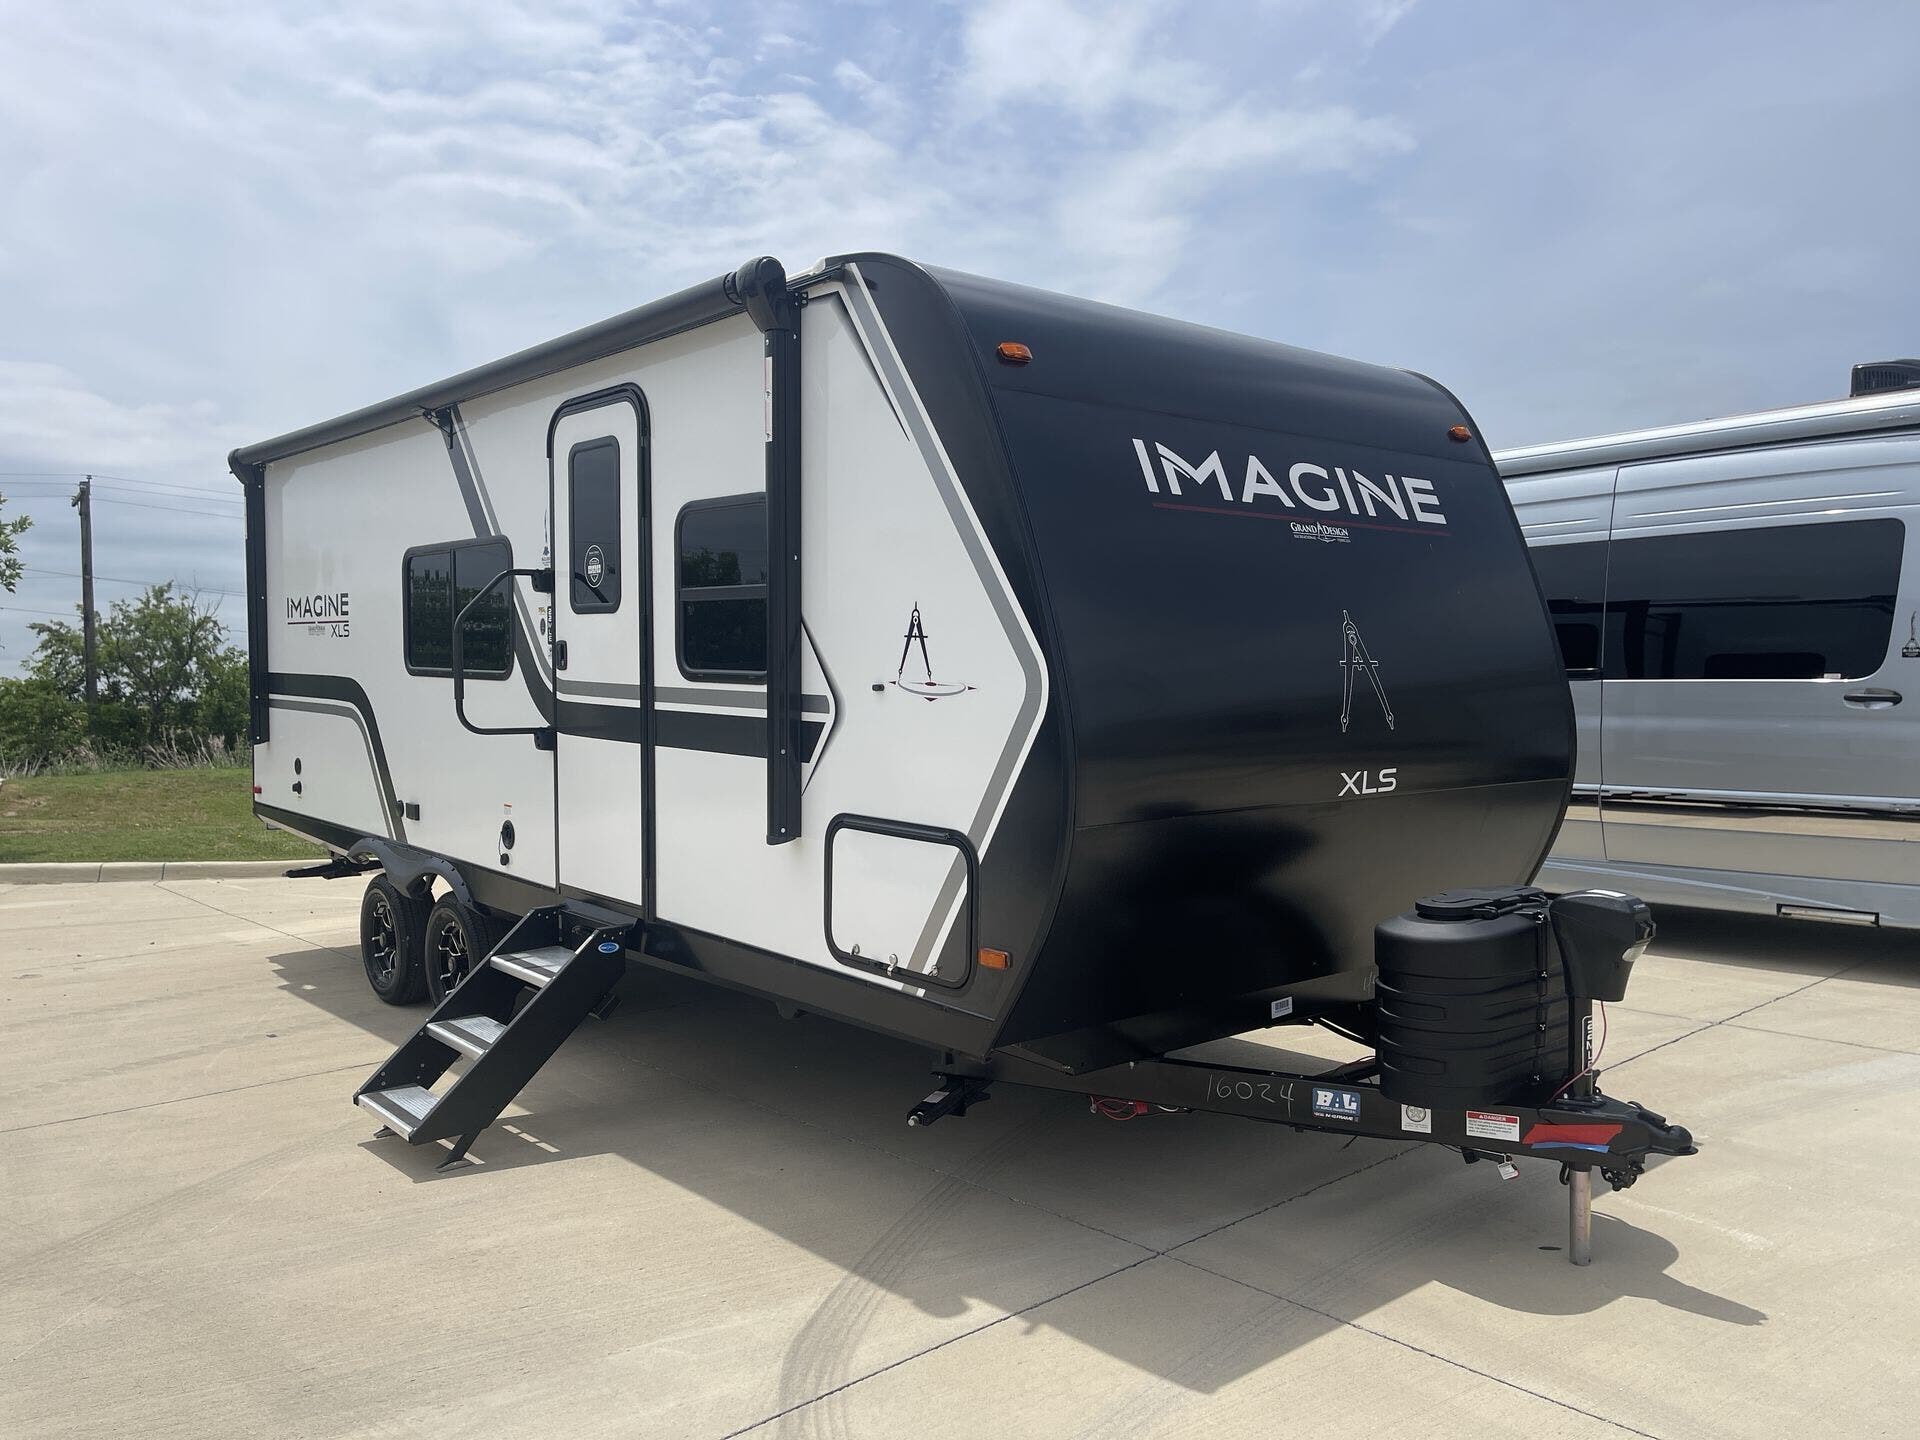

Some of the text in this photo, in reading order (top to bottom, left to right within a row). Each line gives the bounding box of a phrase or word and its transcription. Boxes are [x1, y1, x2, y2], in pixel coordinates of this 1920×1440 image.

[1132, 438, 1447, 525] IMAGINE
[1290, 521, 1349, 536] GRAND DESIGN
[286, 593, 349, 618] IMAGINE
[331, 624, 350, 637] XLS
[1337, 768, 1397, 797] XLS
[1207, 1073, 1295, 1119] 16024
[1483, 1113, 1507, 1122] DANGER
